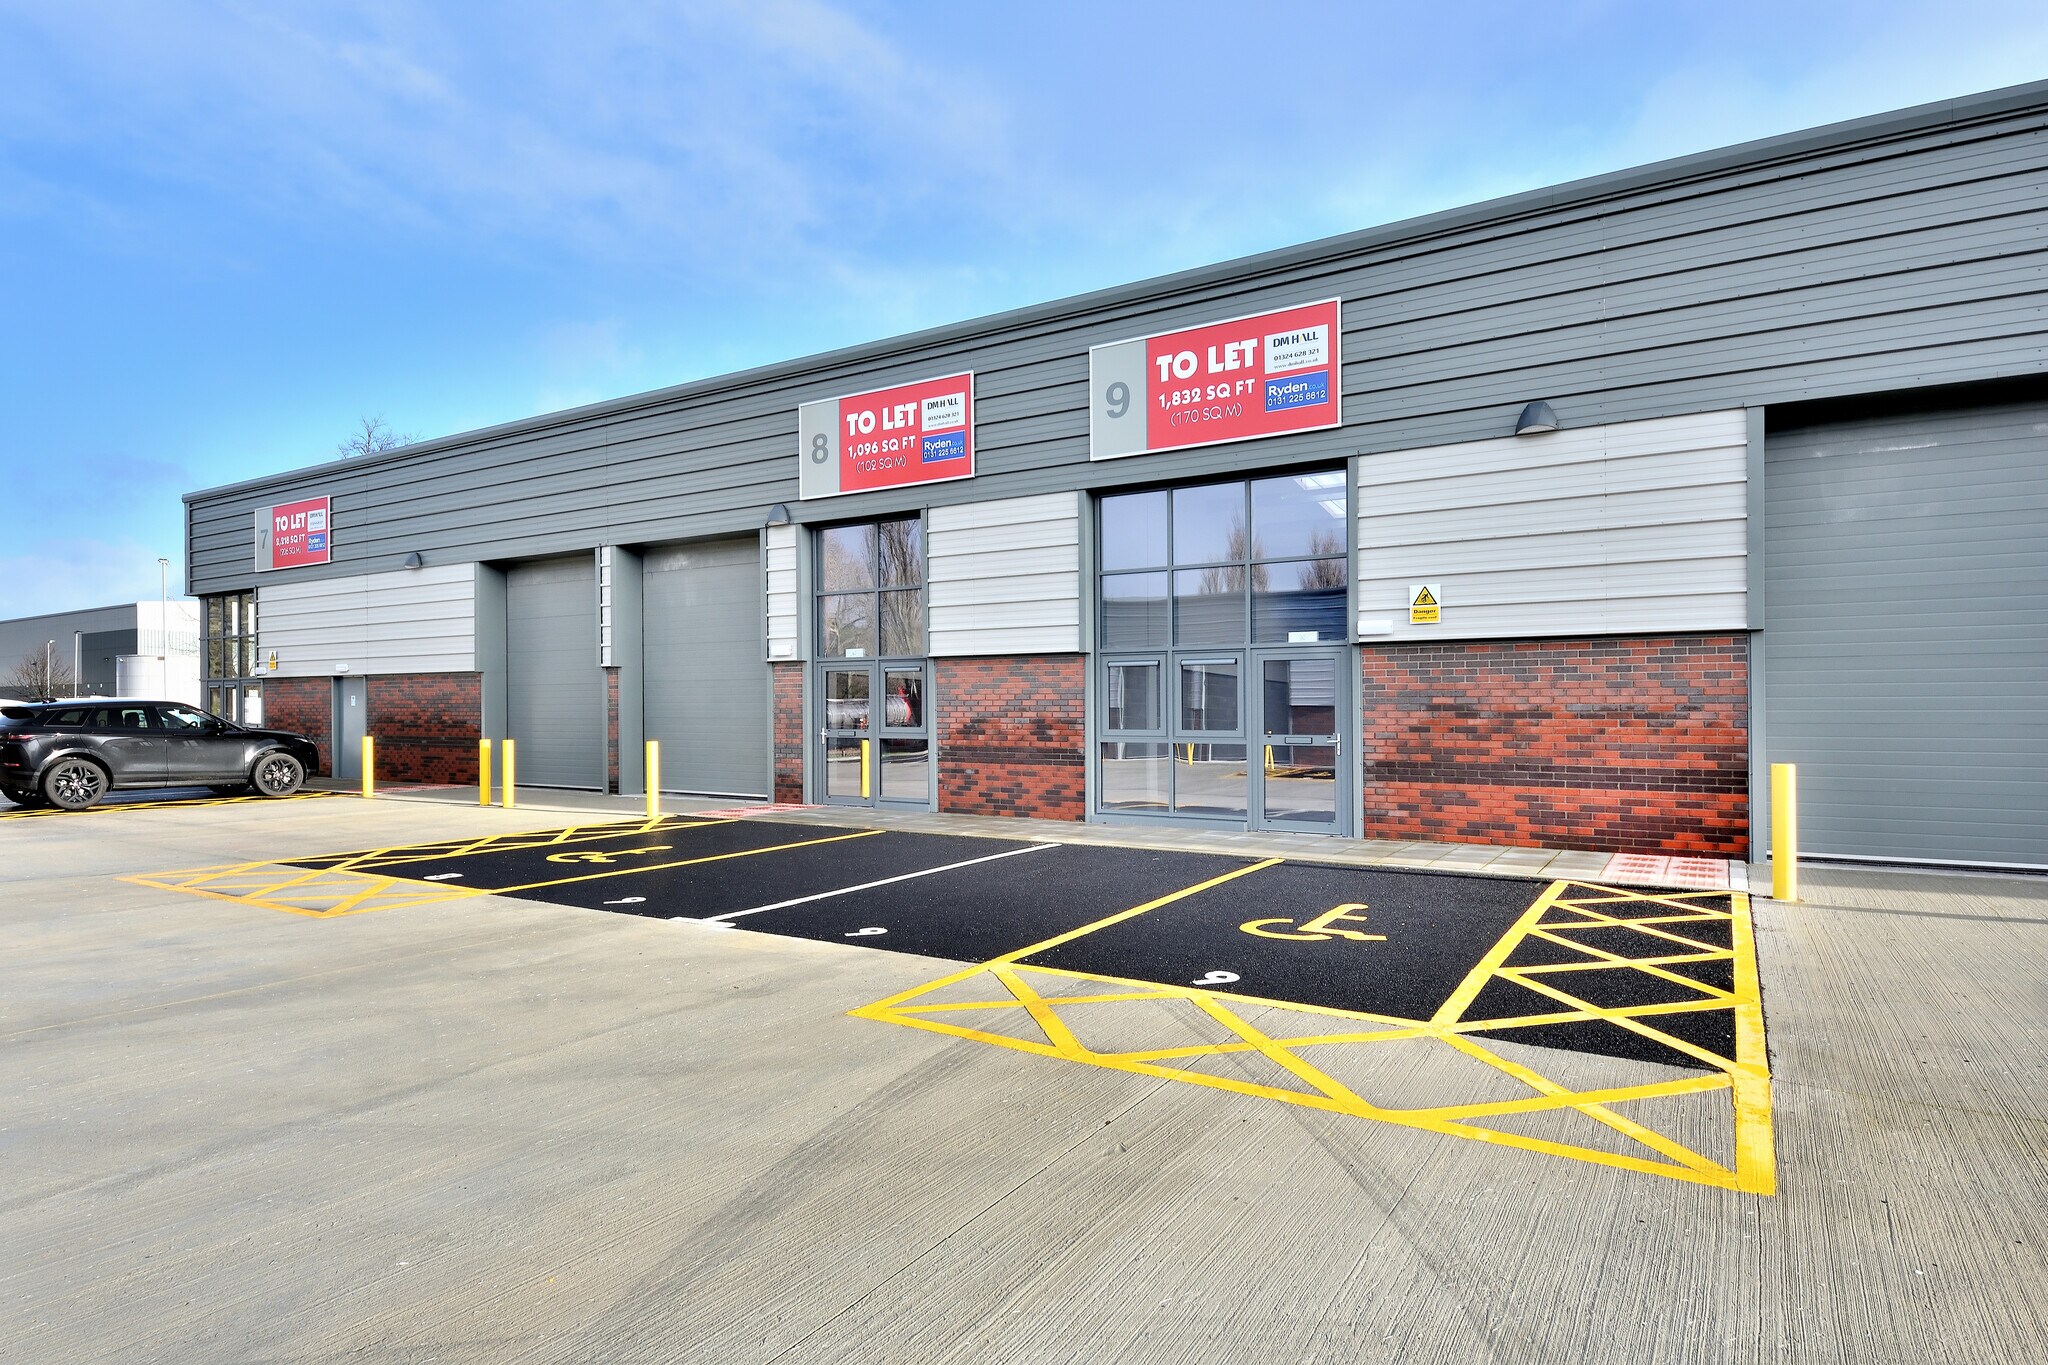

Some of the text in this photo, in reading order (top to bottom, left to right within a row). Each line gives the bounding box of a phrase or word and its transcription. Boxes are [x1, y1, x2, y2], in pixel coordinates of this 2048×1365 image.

[1273, 331, 1319, 348] DM HALL
[1156, 338, 1258, 383] TO LET
[1273, 348, 1319, 361] 01324 628 321
[1105, 381, 1130, 419] 9
[1158, 378, 1256, 411] 1,832 SQ FT
[1267, 396, 1286, 406] 0131
[1289, 393, 1304, 403] 225
[927, 400, 939, 410] DM
[1170, 402, 1242, 427] (170 SQ M)
[846, 402, 918, 437] TO LET
[811, 433, 828, 465] 8
[848, 435, 916, 460] 1,096 SQ FT
[856, 454, 907, 474] (102 SQ M)
[275, 512, 306, 532] TO LET
[260, 529, 268, 549] 7
[290, 534, 298, 544] SQ
[299, 533, 305, 542] FT
